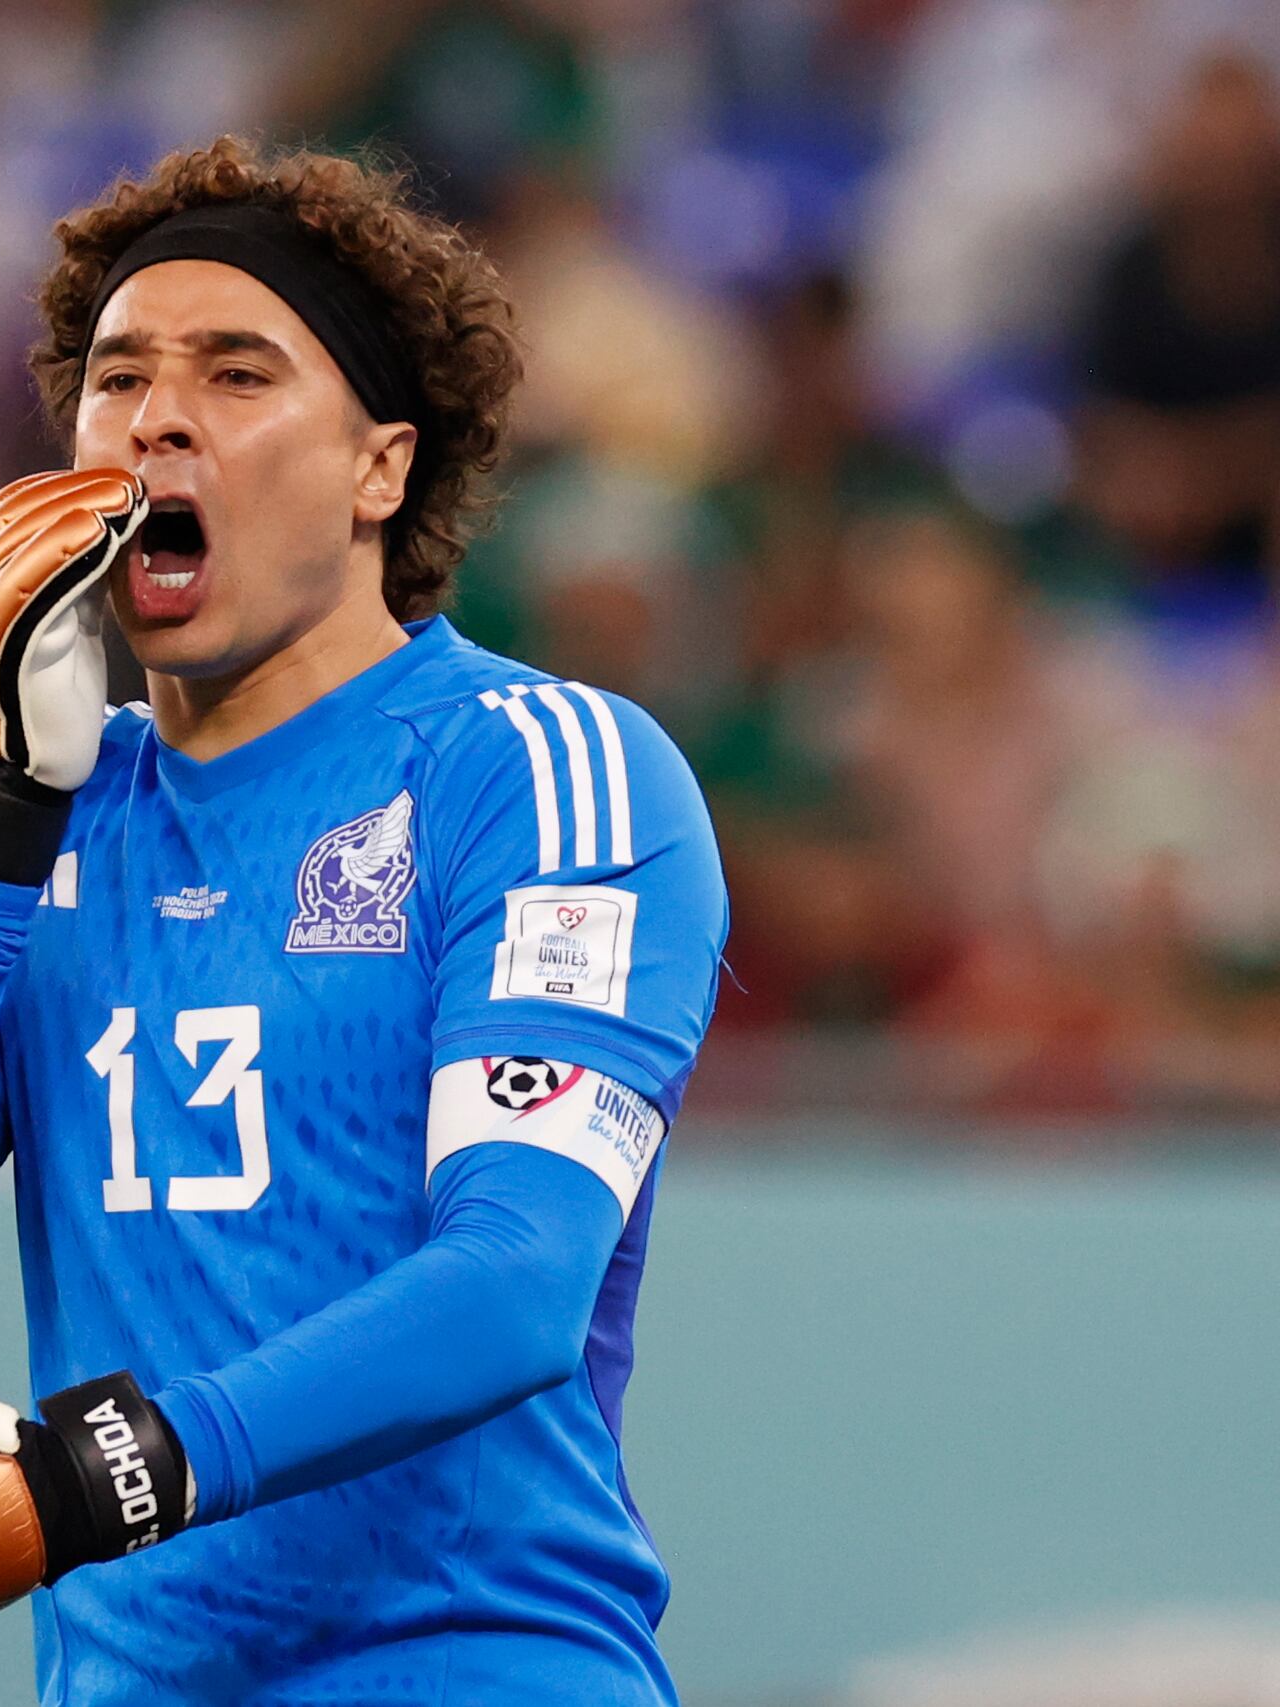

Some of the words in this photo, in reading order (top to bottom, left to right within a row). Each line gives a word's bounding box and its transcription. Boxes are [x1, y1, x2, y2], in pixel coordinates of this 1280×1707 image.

[293, 917, 400, 947] MÉXICO
[540, 933, 587, 951] FOOTBALL
[538, 946, 589, 967] UNITES
[534, 965, 553, 978] the
[554, 965, 591, 982] World
[548, 983, 570, 992] FIFA
[84, 1004, 271, 1213] 13
[595, 1082, 651, 1161] UNITES
[587, 1113, 613, 1139] the
[614, 1131, 641, 1184] World
[83, 1397, 158, 1525] OCHOA
